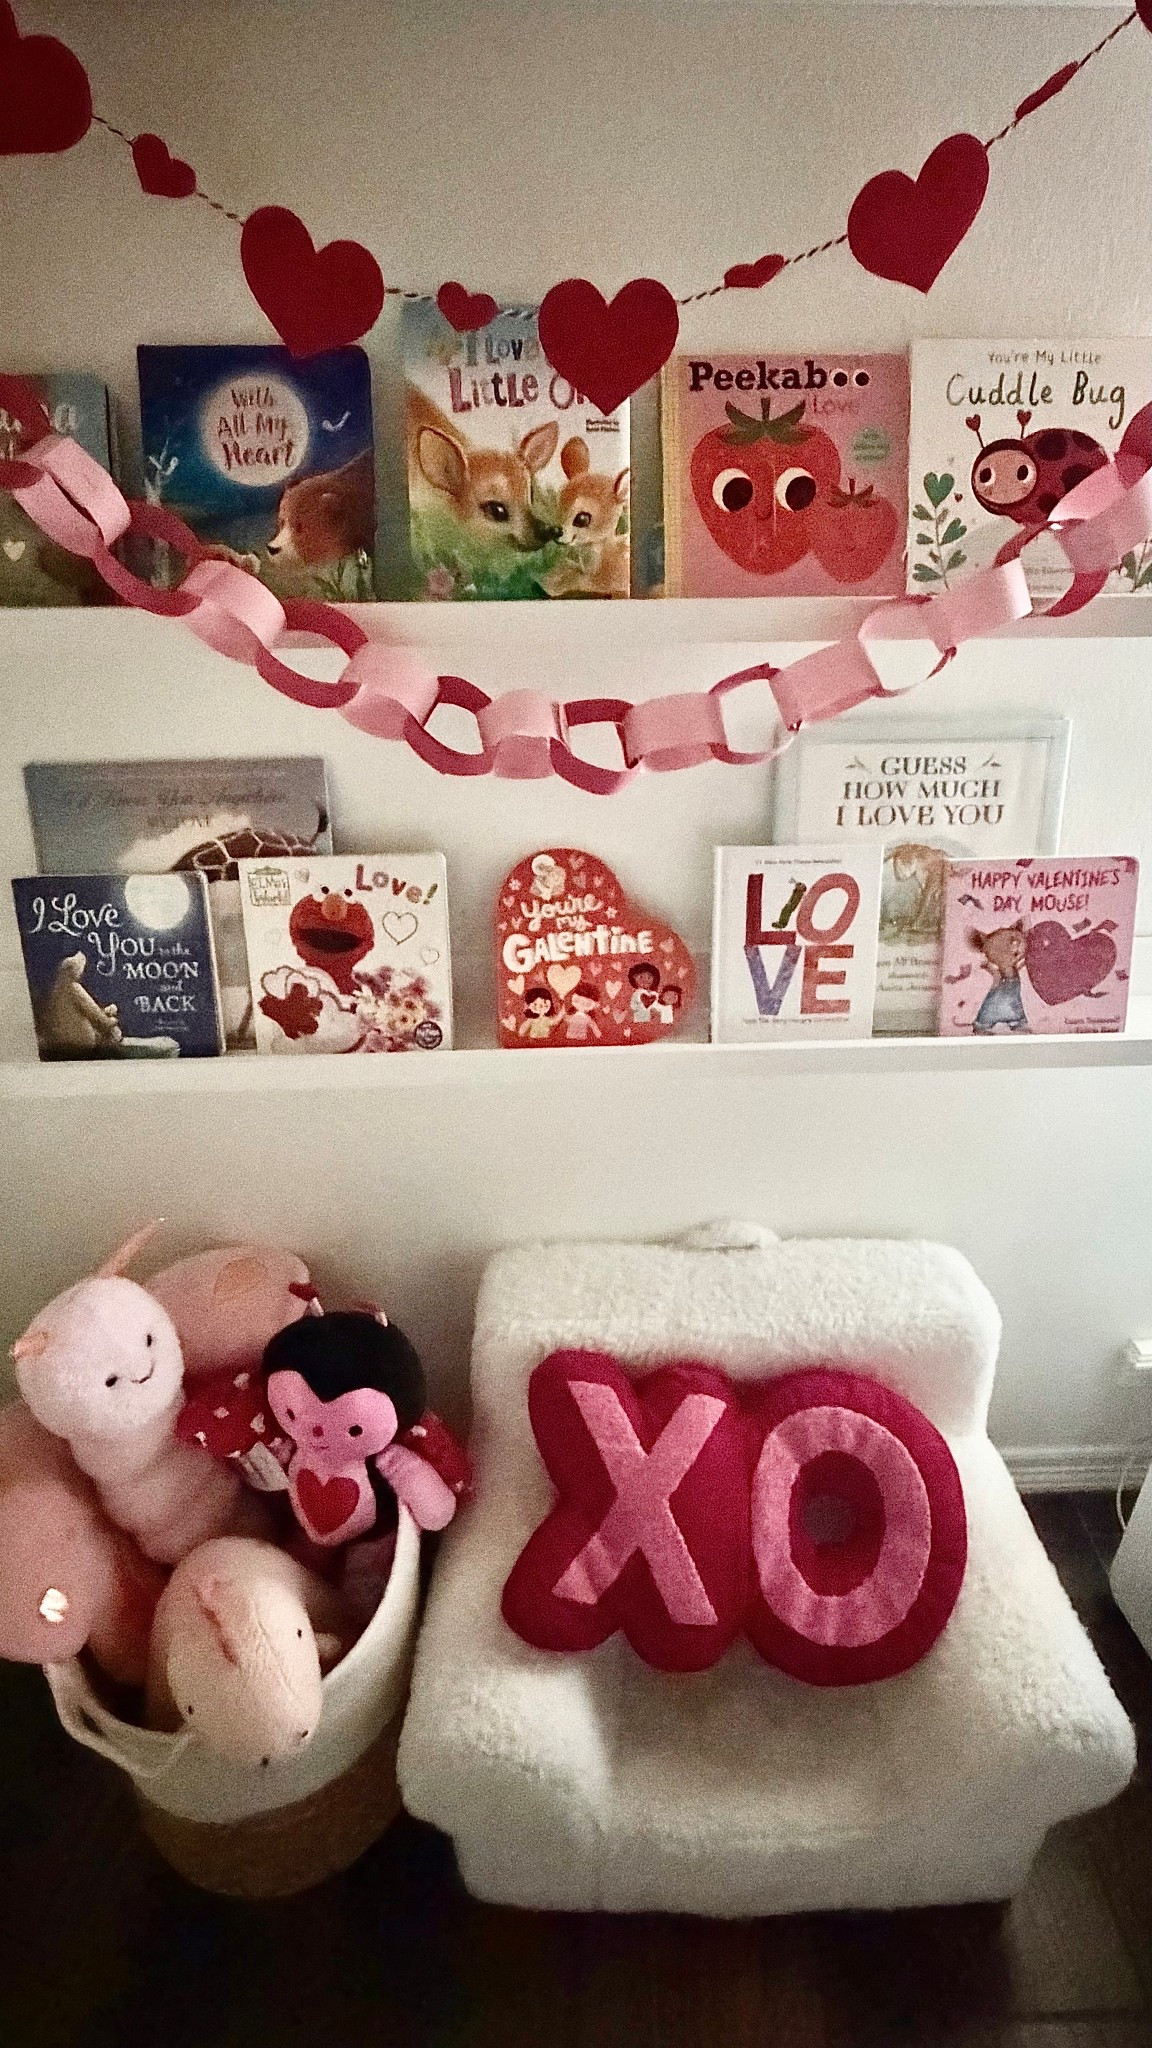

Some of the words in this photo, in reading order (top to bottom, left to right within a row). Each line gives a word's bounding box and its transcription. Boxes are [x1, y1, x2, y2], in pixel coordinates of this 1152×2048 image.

[1035, 350, 1054, 365] My
[231, 387, 274, 408] With
[946, 370, 1053, 406] Cuddle
[1072, 370, 1125, 430] Bug
[217, 412, 246, 438] All
[256, 412, 288, 441] My
[221, 439, 295, 470] Heart
[880, 756, 966, 775] GUESS
[844, 780, 908, 799] HOW
[918, 780, 1002, 799] MUCH
[836, 805, 844, 826] I
[857, 805, 934, 826] LOVE
[944, 804, 1004, 826] YOU
[356, 863, 439, 905] Love!
[971, 871, 1023, 890] HAPPY
[1030, 893, 1090, 913] MOUSE!
[29, 897, 46, 934] I
[48, 893, 122, 937] Love
[556, 915, 593, 931] my
[172, 943, 191, 956] the
[123, 961, 199, 980] MOON
[160, 980, 185, 992] and
[134, 995, 197, 1013] BACK
[551, 1380, 932, 1648] XO
